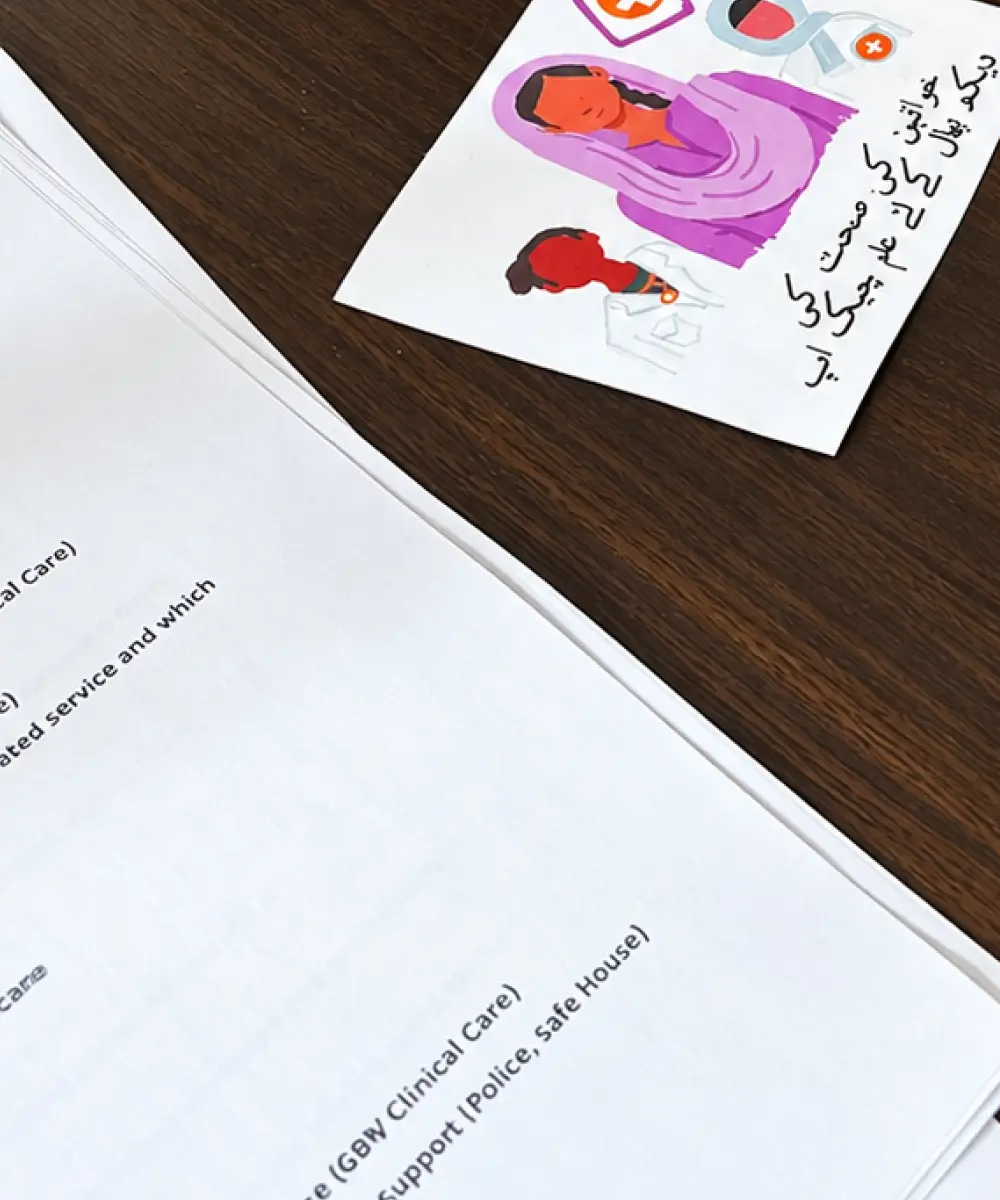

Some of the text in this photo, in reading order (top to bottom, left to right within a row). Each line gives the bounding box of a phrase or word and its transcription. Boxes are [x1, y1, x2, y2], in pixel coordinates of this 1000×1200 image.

[20, 540, 77, 585] Care)
[45, 664, 118, 727] service
[118, 625, 158, 664] and
[156, 579, 216, 629] which
[574, 924, 650, 998] House)
[385, 1039, 465, 1122] Clinical
[461, 983, 522, 1042] Care)
